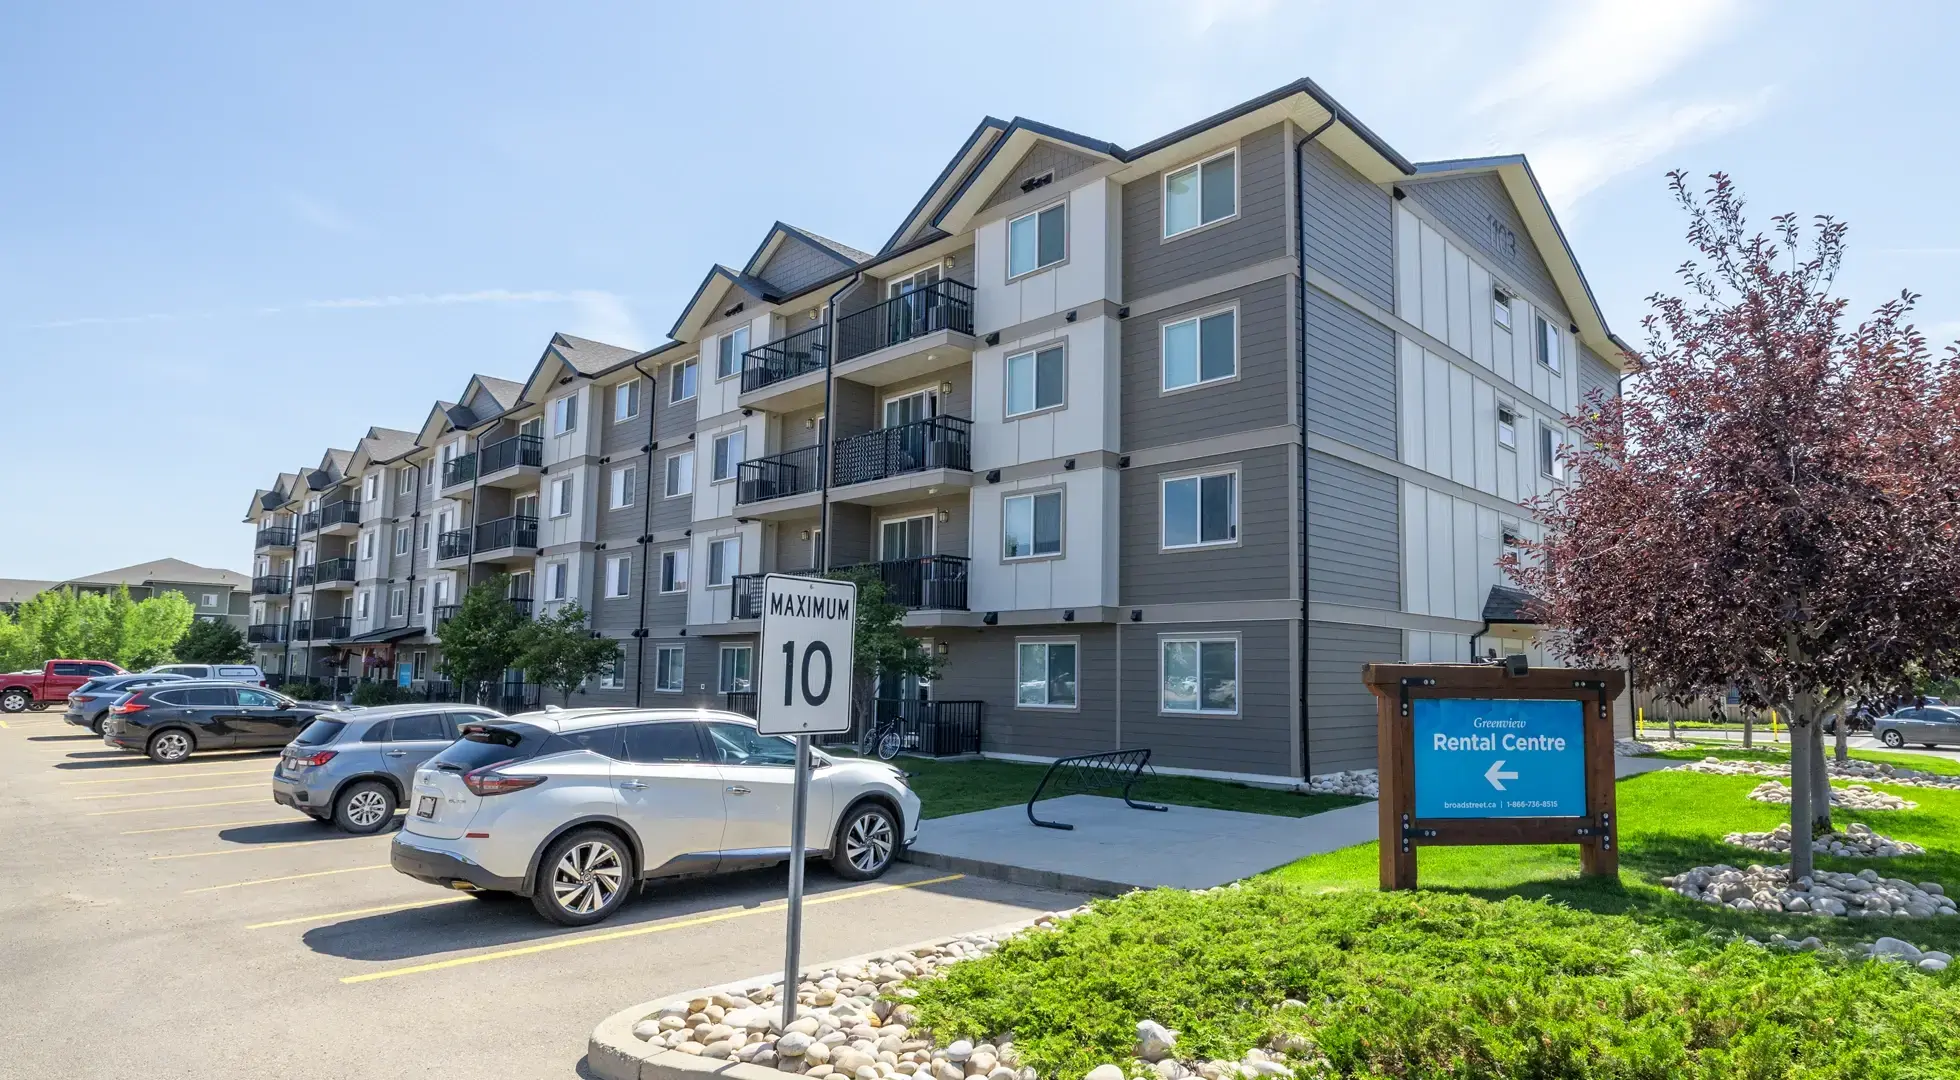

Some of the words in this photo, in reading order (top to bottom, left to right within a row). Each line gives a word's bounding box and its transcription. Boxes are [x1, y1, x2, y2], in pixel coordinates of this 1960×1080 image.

[770, 592, 849, 620] MAXIMUM
[782, 640, 833, 707] 10
[1473, 717, 1526, 728] Greenview
[1433, 733, 1496, 751] Rental
[1502, 733, 1566, 751] Centre
[1444, 801, 1497, 809] broadstreet.ca
[1506, 800, 1558, 808] 1-866-736-8515
